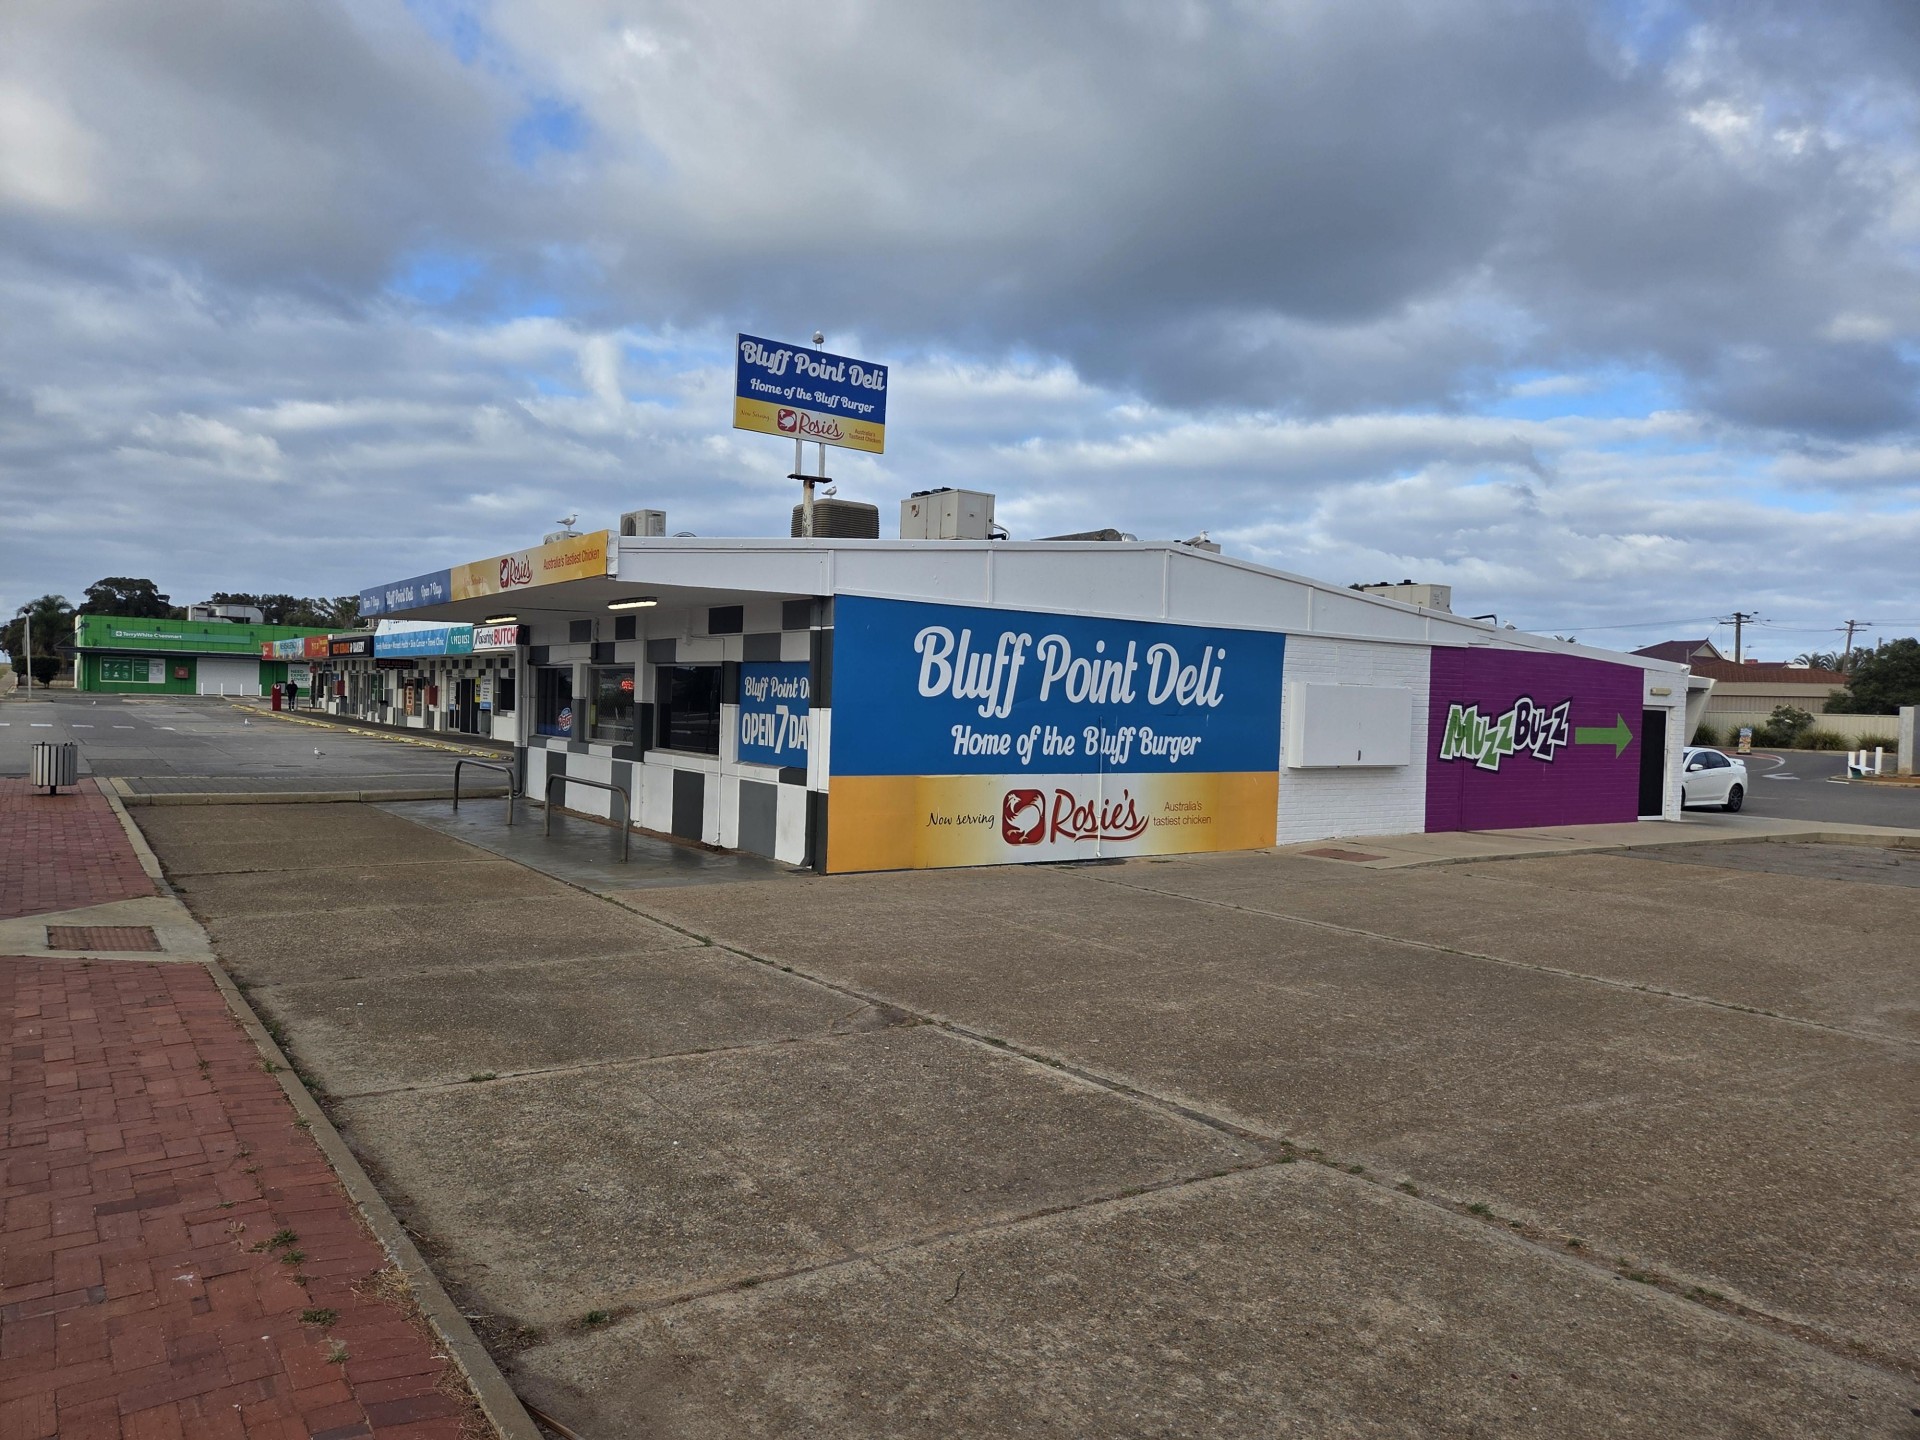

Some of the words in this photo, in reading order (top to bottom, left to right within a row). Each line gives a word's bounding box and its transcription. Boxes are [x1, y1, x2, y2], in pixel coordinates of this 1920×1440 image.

[741, 340, 793, 376] Bluff
[794, 353, 845, 383] Point
[849, 364, 885, 391] Deli
[750, 378, 782, 395] Home
[784, 387, 795, 400] of
[796, 388, 812, 401] the
[814, 391, 841, 408] Bluff
[841, 396, 875, 414] Burger
[799, 412, 845, 441] Rosie's
[509, 555, 533, 587] Rosie's
[543, 560, 565, 575] Australia's
[565, 553, 582, 571] Tastiest
[582, 549, 600, 567] Chicken
[494, 627, 517, 645] BUTCH
[914, 625, 1032, 719] Bluff
[1037, 633, 1138, 704] Point
[1147, 640, 1226, 708] Deli
[744, 676, 769, 702] Bluff
[770, 676, 798, 698] Point
[741, 712, 776, 747] OPEN
[774, 704, 789, 754] 7
[951, 724, 1010, 755] Home
[1017, 725, 1041, 765] of
[1042, 726, 1075, 755] the
[1083, 726, 1136, 765] Bluff
[1138, 726, 1201, 763] Burger
[926, 811, 954, 828] Now
[955, 813, 995, 830] serving
[1050, 788, 1149, 844] Rosie's
[1153, 815, 1181, 826] tastiest
[1182, 814, 1212, 826] chicken
[1164, 800, 1203, 812] Australia's
